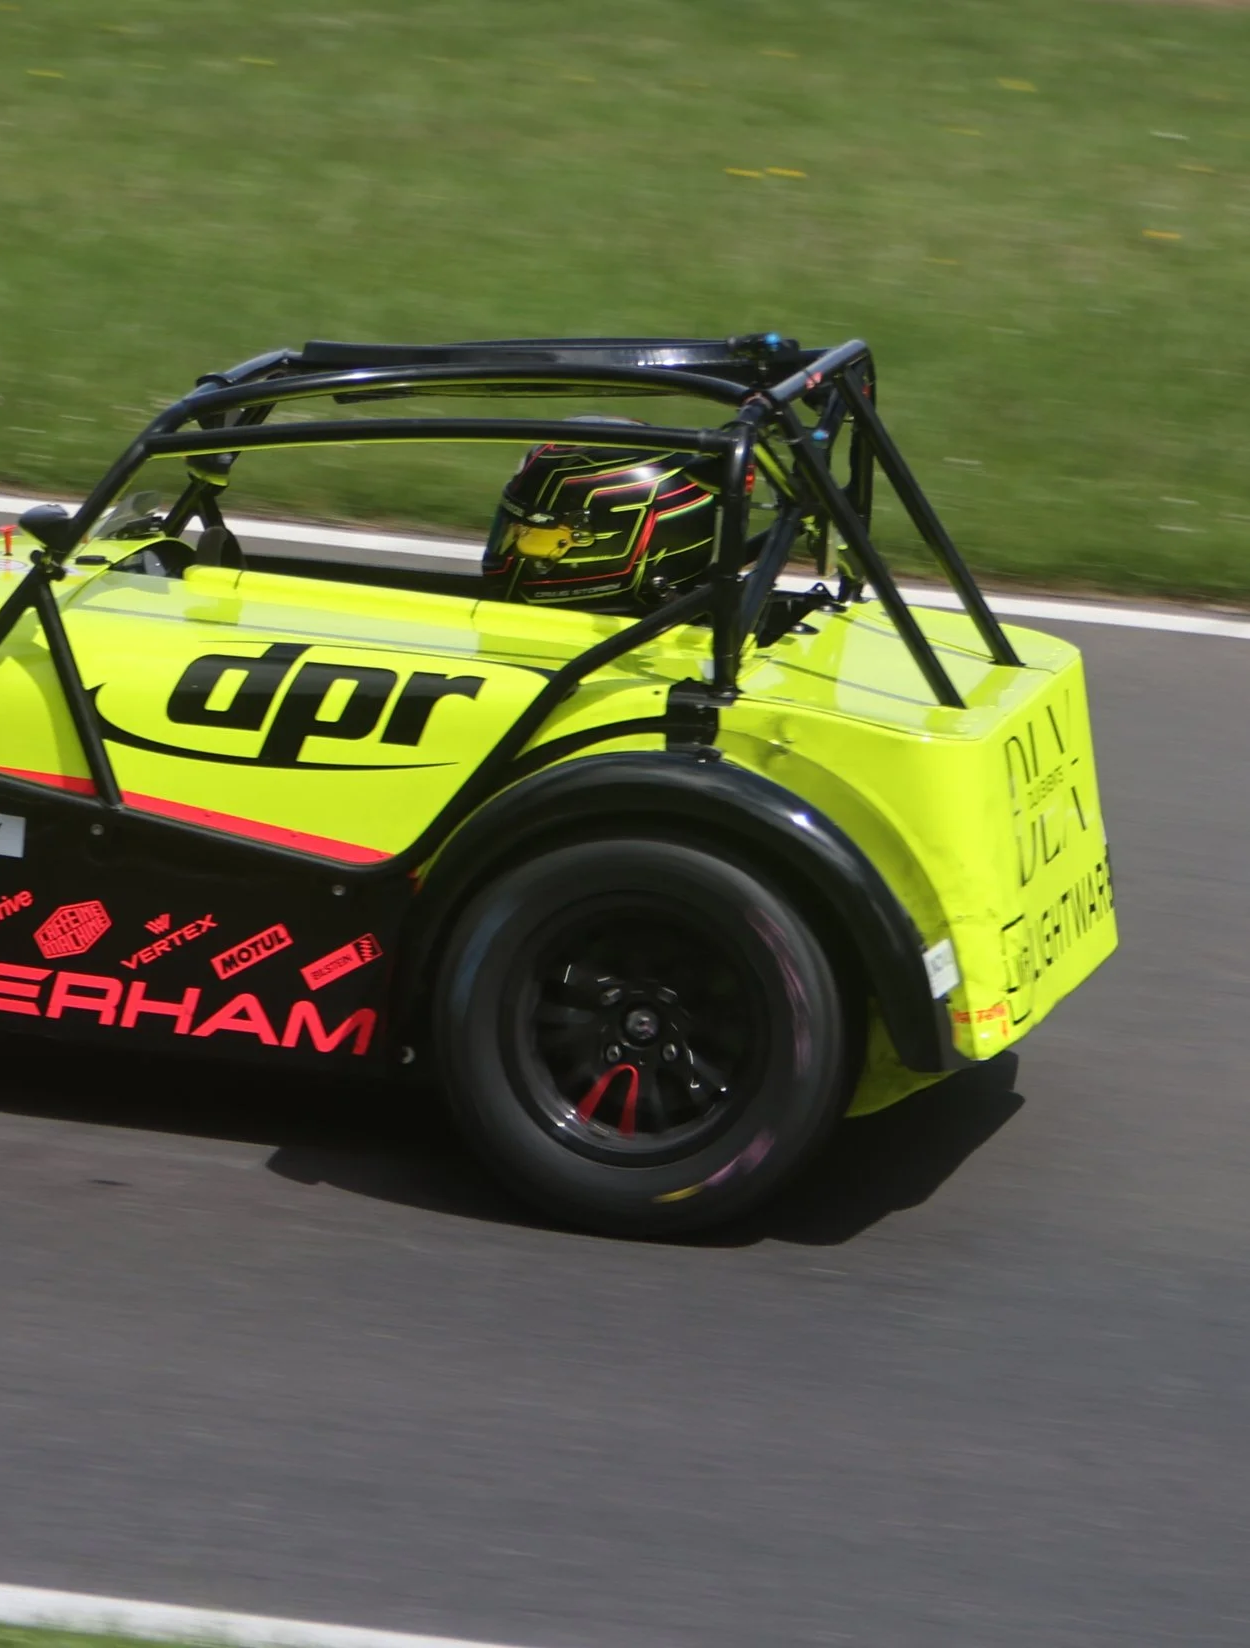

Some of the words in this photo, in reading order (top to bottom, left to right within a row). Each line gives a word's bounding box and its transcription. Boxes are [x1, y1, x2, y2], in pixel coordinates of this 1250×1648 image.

[166, 643, 486, 766] dpr
[120, 914, 218, 970] VERTEX
[220, 929, 286, 975] MOTUL
